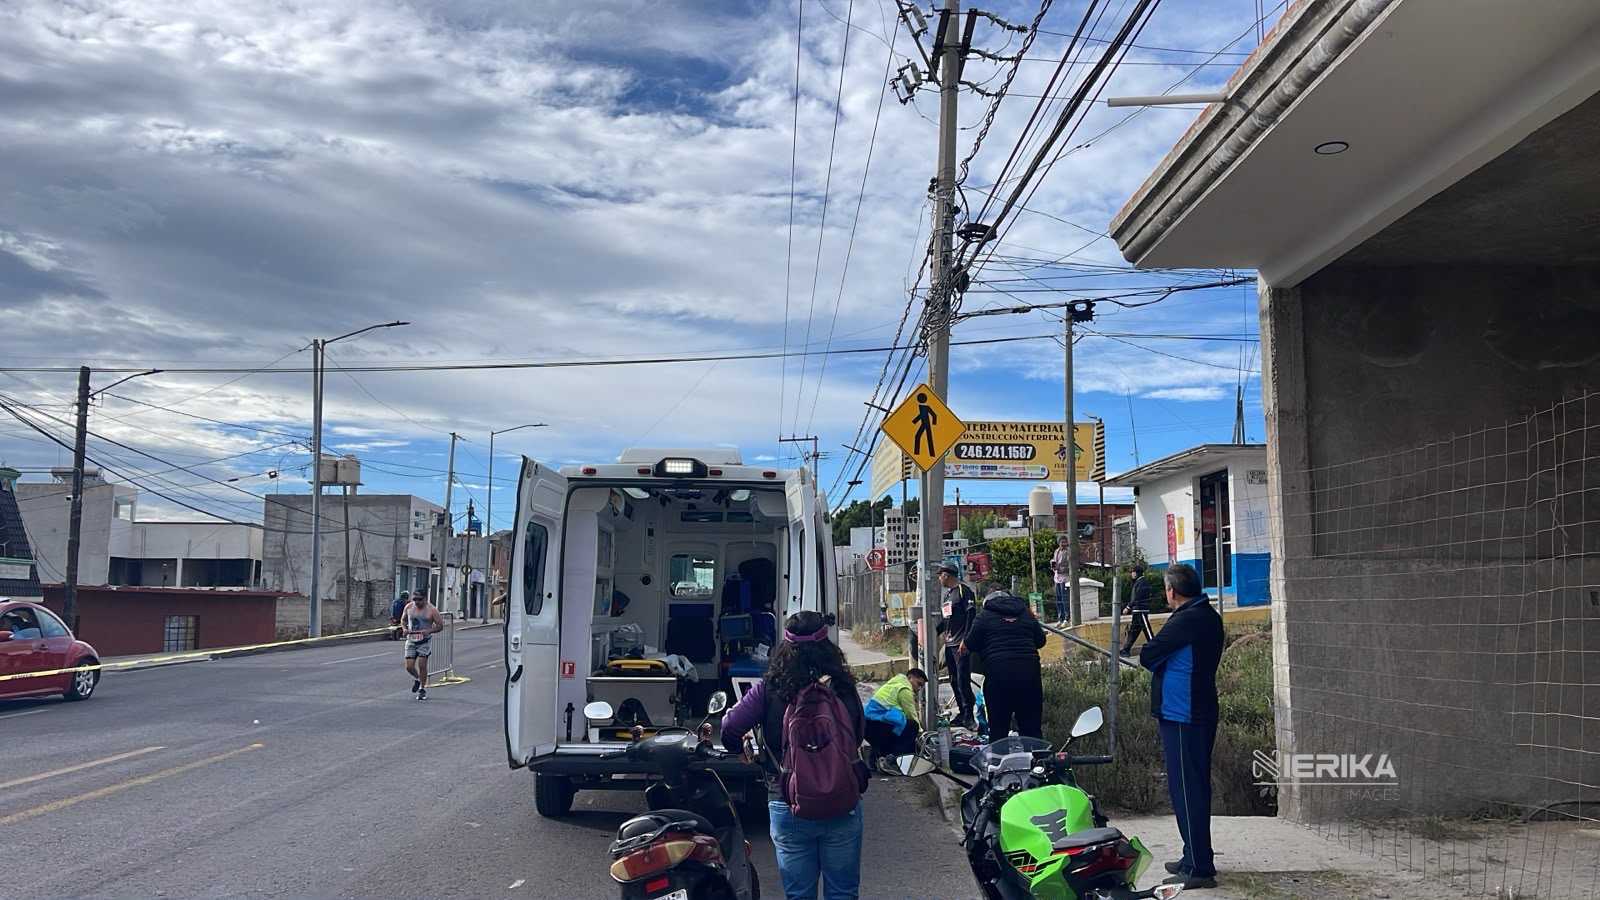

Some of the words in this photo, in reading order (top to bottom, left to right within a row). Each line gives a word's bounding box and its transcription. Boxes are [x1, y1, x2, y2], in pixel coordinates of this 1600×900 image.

[966, 424, 998, 432] TERIA
[1001, 424, 1008, 432] Y
[1010, 424, 1079, 433] MATERIALS
[961, 433, 1024, 441] ONSTRUCCIÓN
[960, 445, 1033, 459] 246.241.1587
